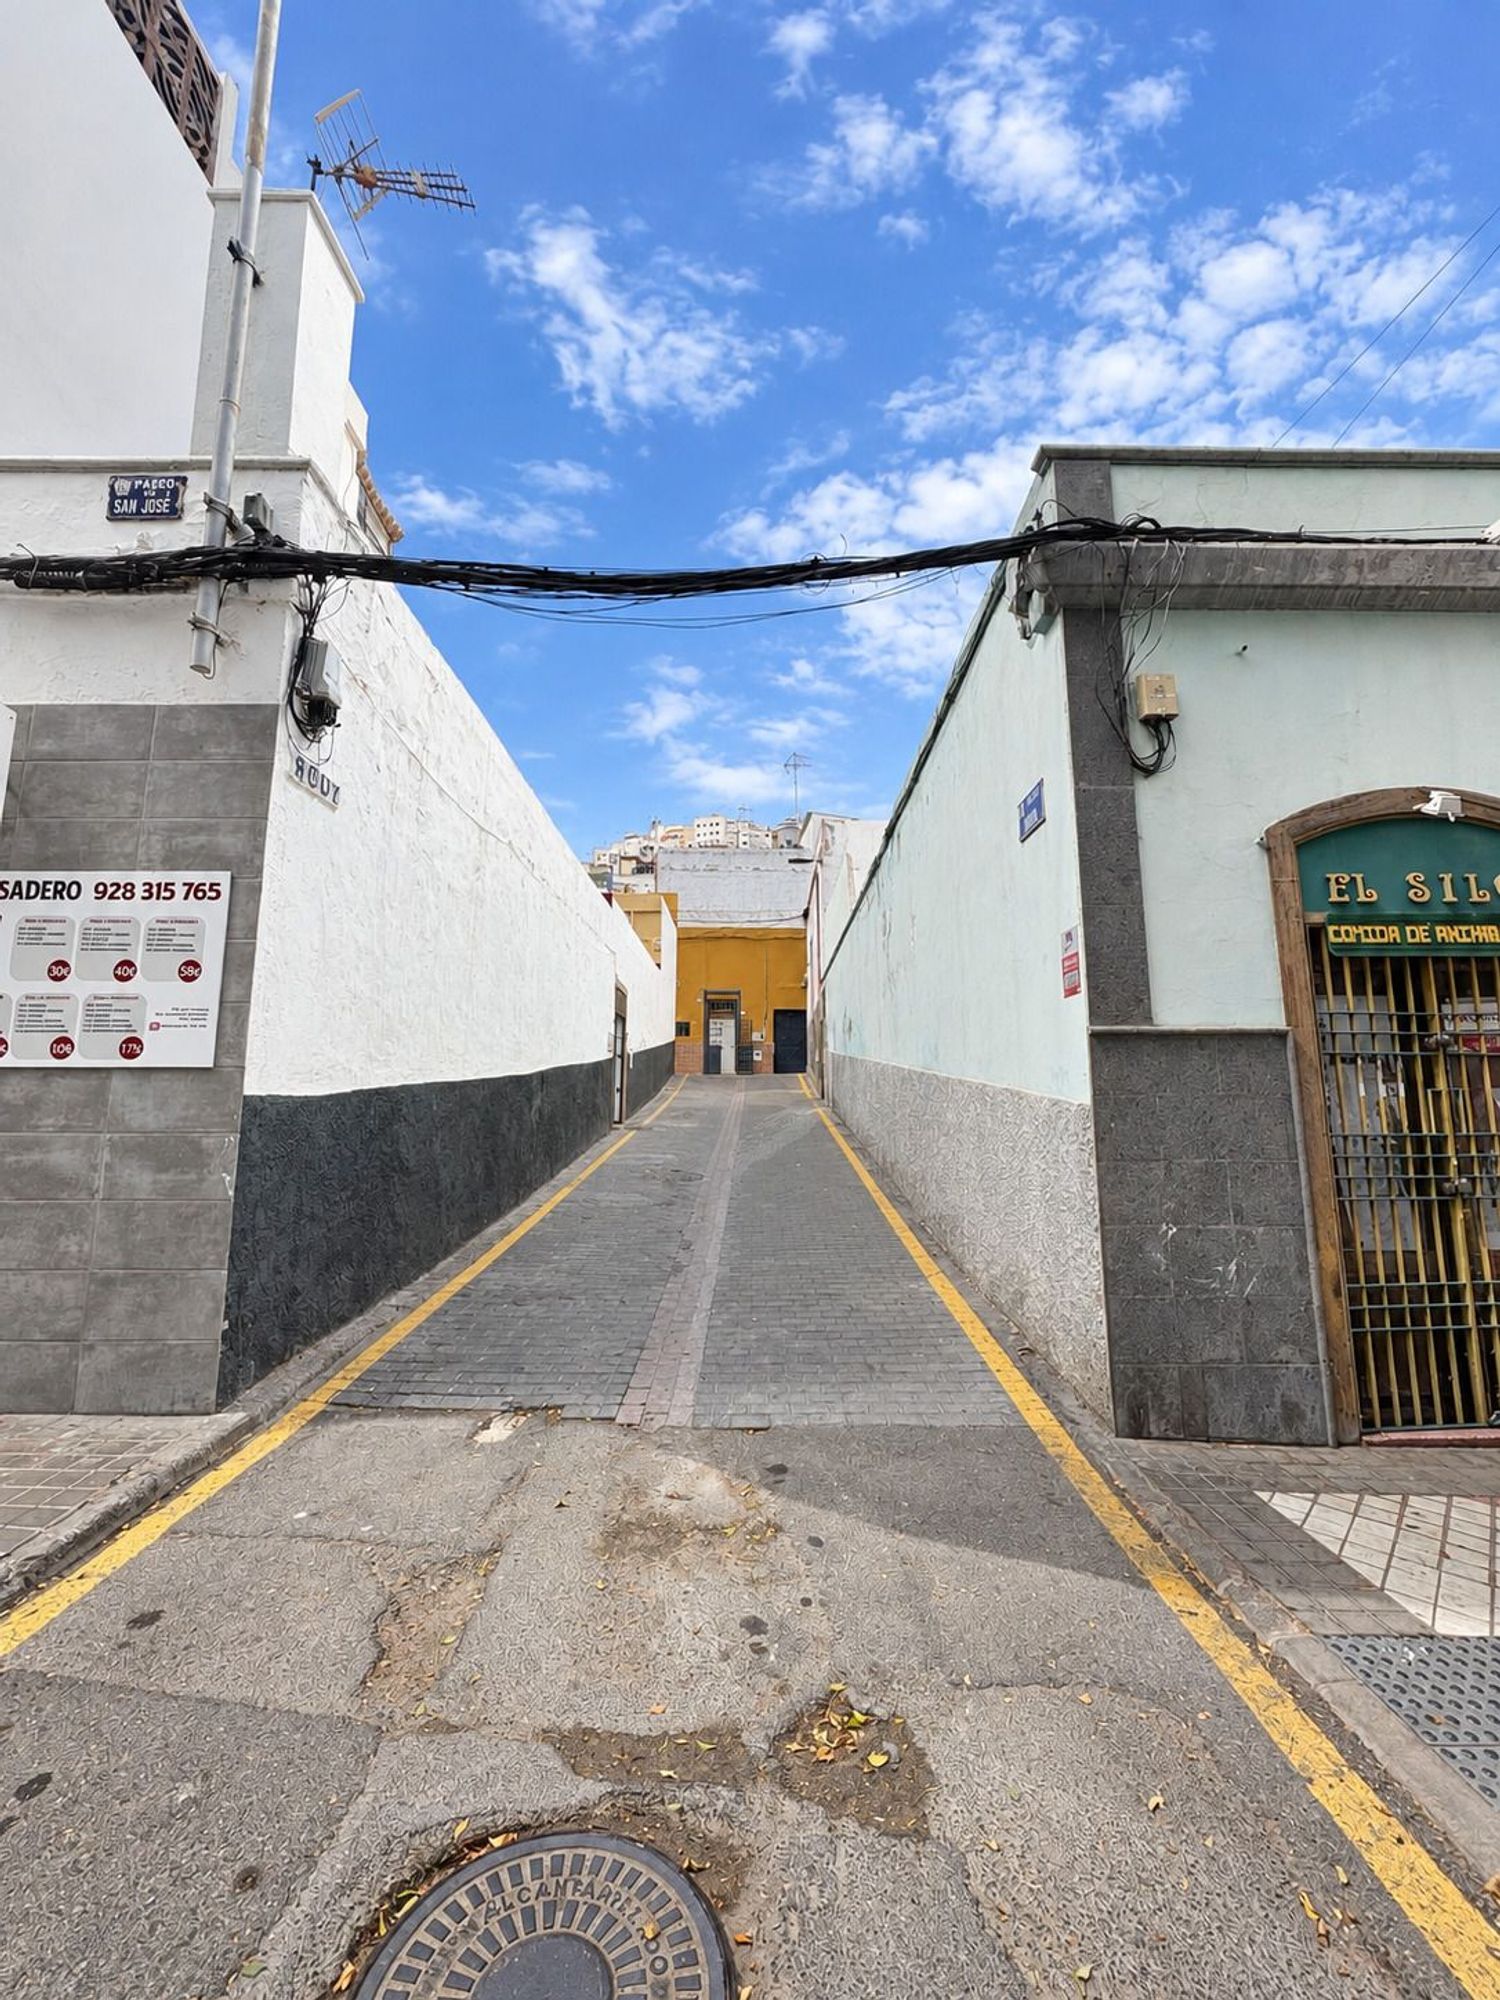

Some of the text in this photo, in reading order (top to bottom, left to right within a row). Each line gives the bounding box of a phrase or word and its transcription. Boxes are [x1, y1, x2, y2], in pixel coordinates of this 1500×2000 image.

[113, 499, 137, 514] SAN
[93, 882, 136, 901] 928
[141, 882, 176, 901] 315
[182, 882, 222, 901] 765
[1325, 872, 1500, 903] EL SIL
[1327, 925, 1401, 943] COMIDA
[1405, 925, 1432, 943] DE
